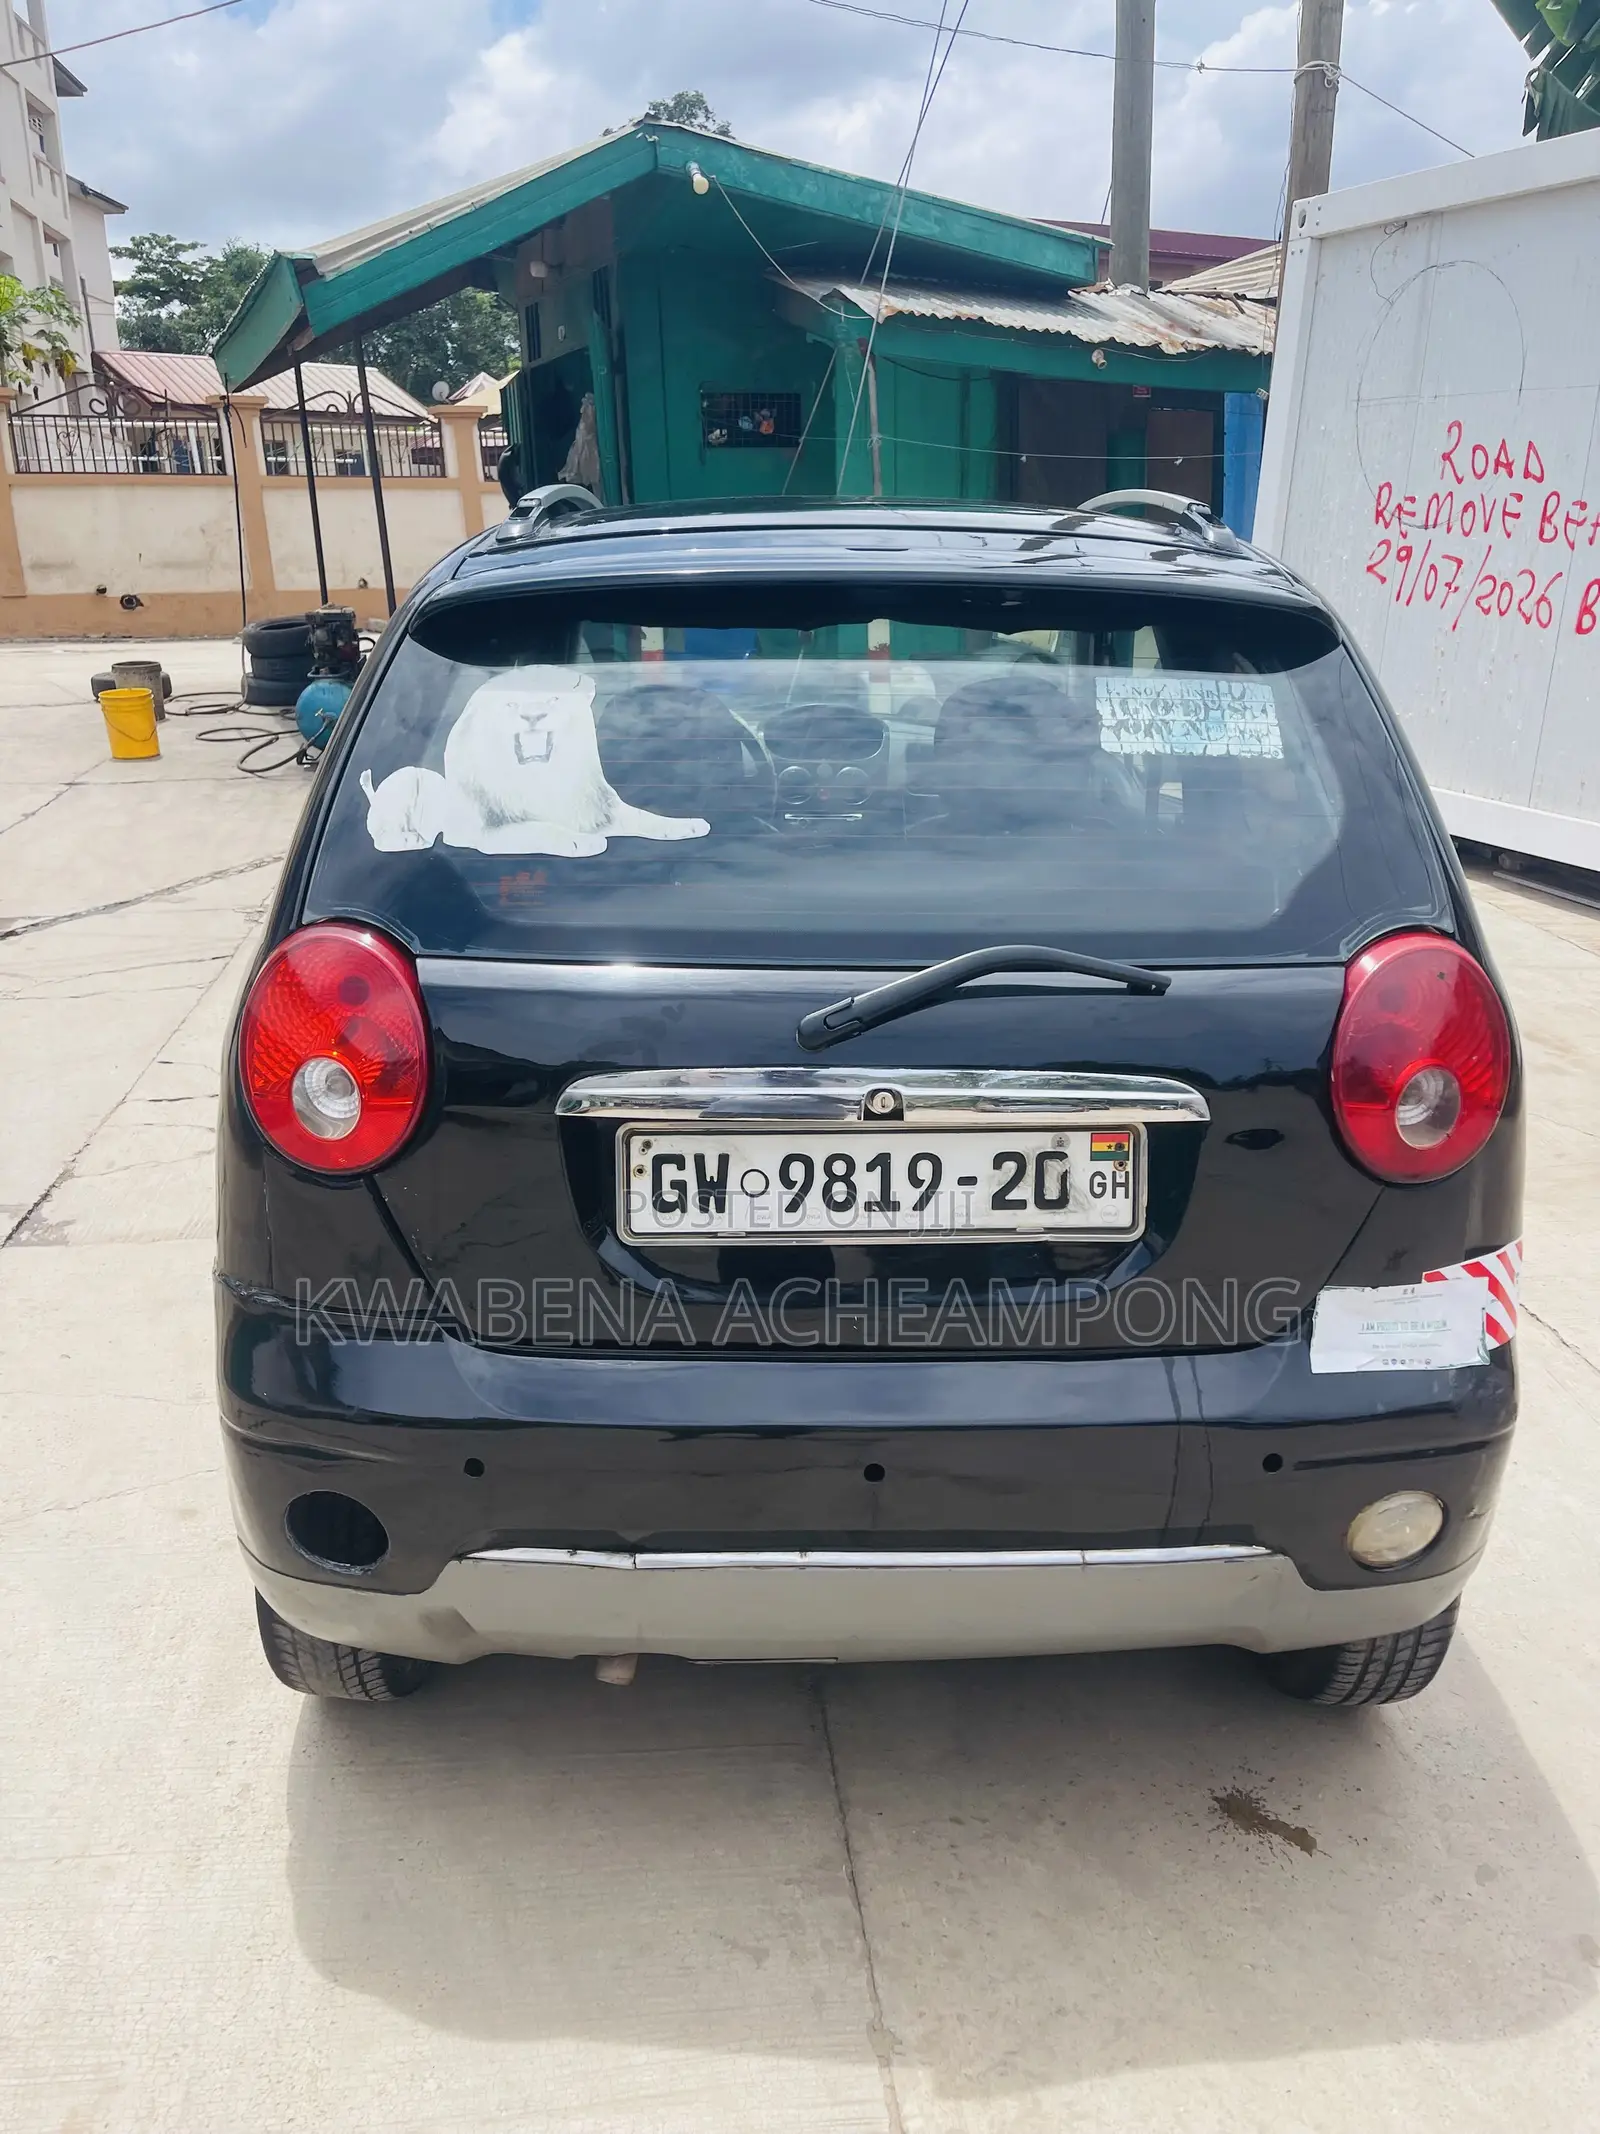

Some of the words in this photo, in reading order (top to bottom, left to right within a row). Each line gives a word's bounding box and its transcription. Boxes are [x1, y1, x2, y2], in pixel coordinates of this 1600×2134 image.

[1440, 419, 1545, 485] ROAD
[1375, 481, 1524, 540] REMOVE
[1366, 538, 1564, 632] 29/07/2026
[651, 1152, 731, 1214] GW
[1089, 1170, 1130, 1200] GH
